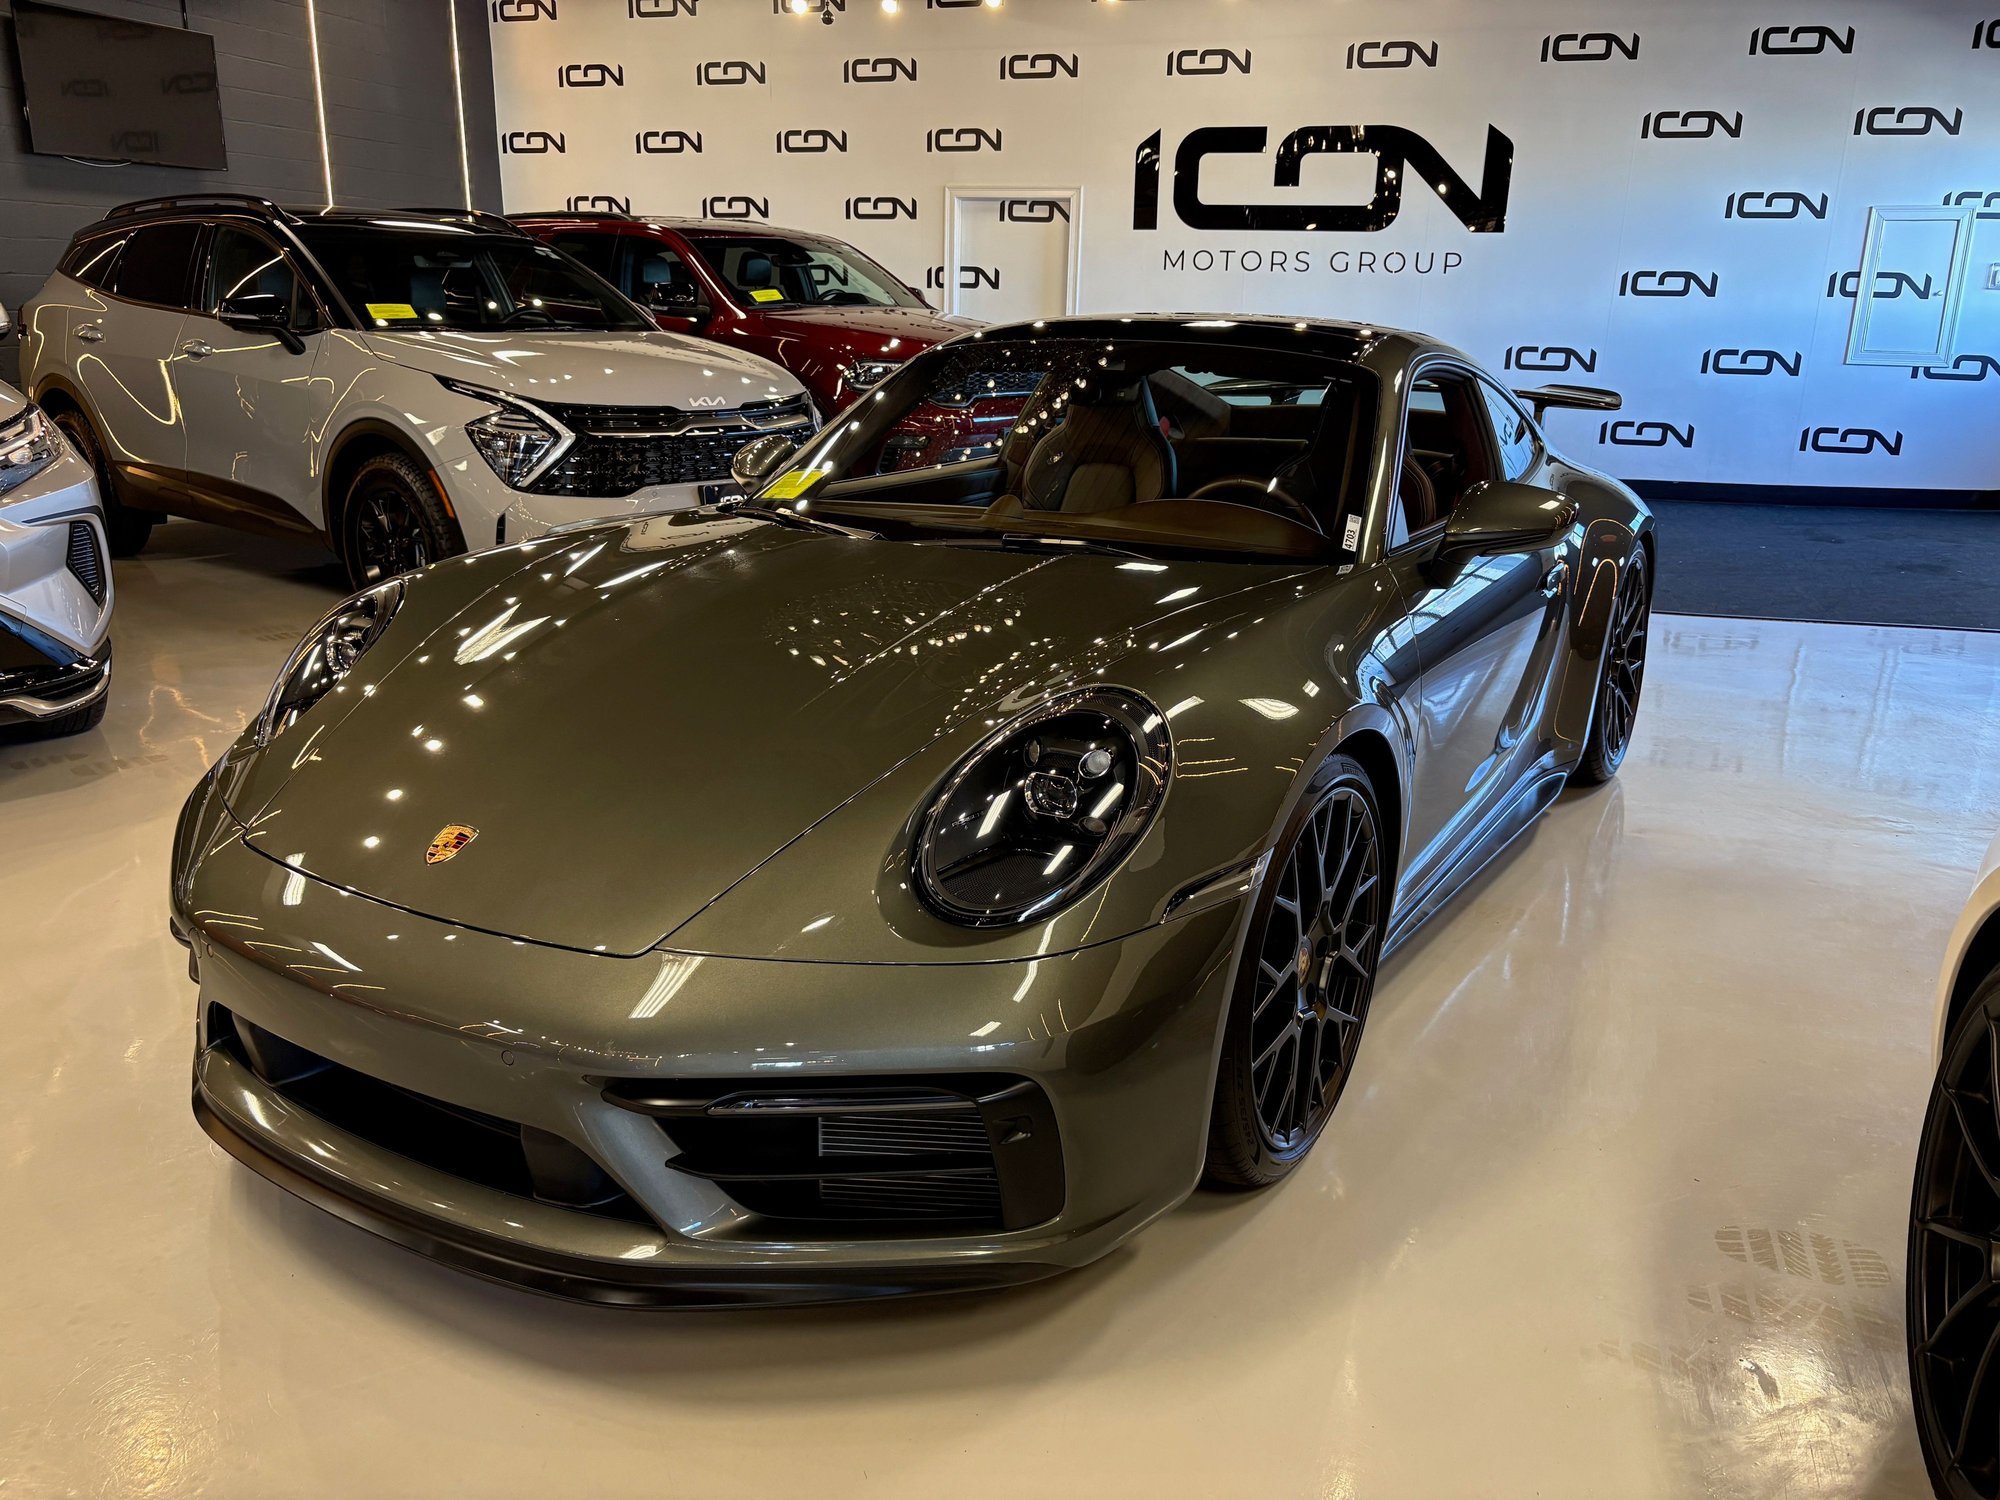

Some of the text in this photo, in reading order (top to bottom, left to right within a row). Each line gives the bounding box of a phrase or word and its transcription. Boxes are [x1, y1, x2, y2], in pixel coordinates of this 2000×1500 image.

[1541, 33, 1640, 62] ICON
[1749, 26, 1855, 55] ICON
[1000, 54, 1079, 80] ICON
[1167, 48, 1252, 76] ICON
[1347, 41, 1439, 69] ICON
[558, 64, 624, 87] ICON
[697, 62, 766, 86] ICON
[844, 58, 917, 83] ICON
[1641, 111, 1743, 139] ICON
[1854, 107, 1963, 136] ICON
[502, 131, 565, 154] ICON
[635, 131, 702, 154] ICON
[777, 130, 848, 153] ICON
[926, 128, 1001, 153] ICON
[1133, 123, 1514, 233] ICON
[703, 197, 769, 219] ICON
[846, 197, 917, 220] ICON
[1724, 192, 1829, 219] ICON
[1163, 249, 1464, 275] MOTORS GROUP
[1619, 271, 1719, 298] ICON
[1504, 346, 1597, 373] ICON
[1701, 348, 1802, 376] ICON
[1599, 420, 1695, 448] ICON
[1799, 426, 1904, 455] ICON
[1345, 529, 1356, 549] 4703
